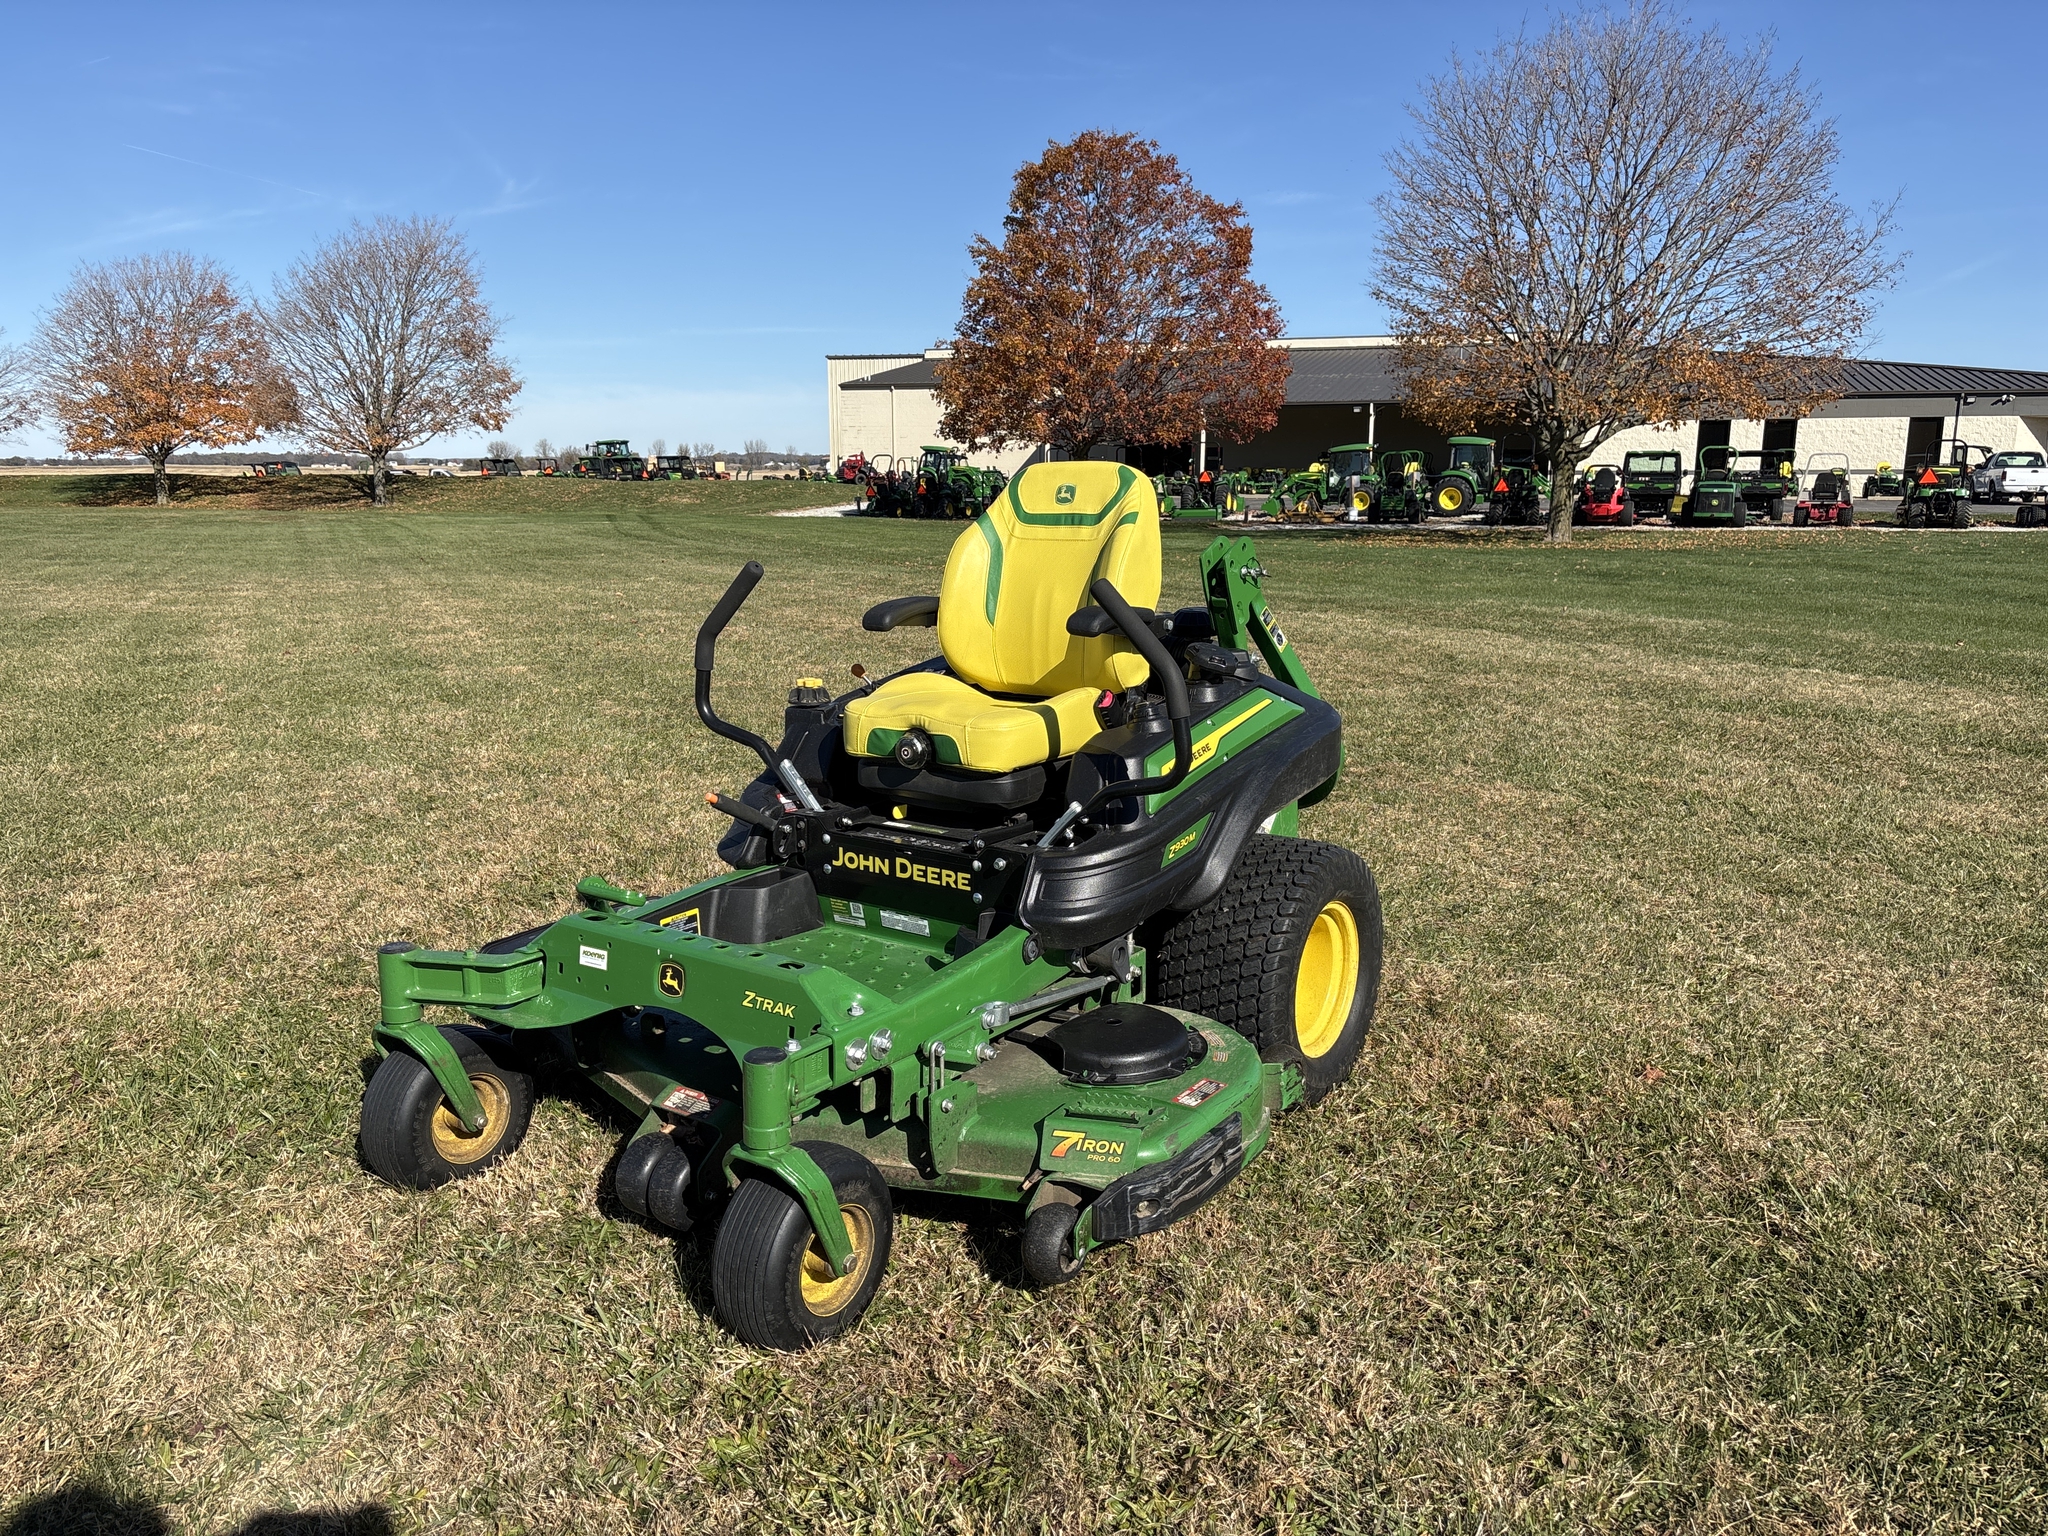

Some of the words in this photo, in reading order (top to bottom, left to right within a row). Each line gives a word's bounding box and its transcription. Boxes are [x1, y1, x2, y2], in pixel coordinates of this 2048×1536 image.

[1191, 743, 1212, 761] EERE
[1168, 831, 1196, 859] Z930M
[832, 846, 890, 876] JOHN
[895, 857, 972, 892] DEERE
[742, 990, 797, 1019] ZTRAK
[1086, 1154, 1106, 1162] PRO
